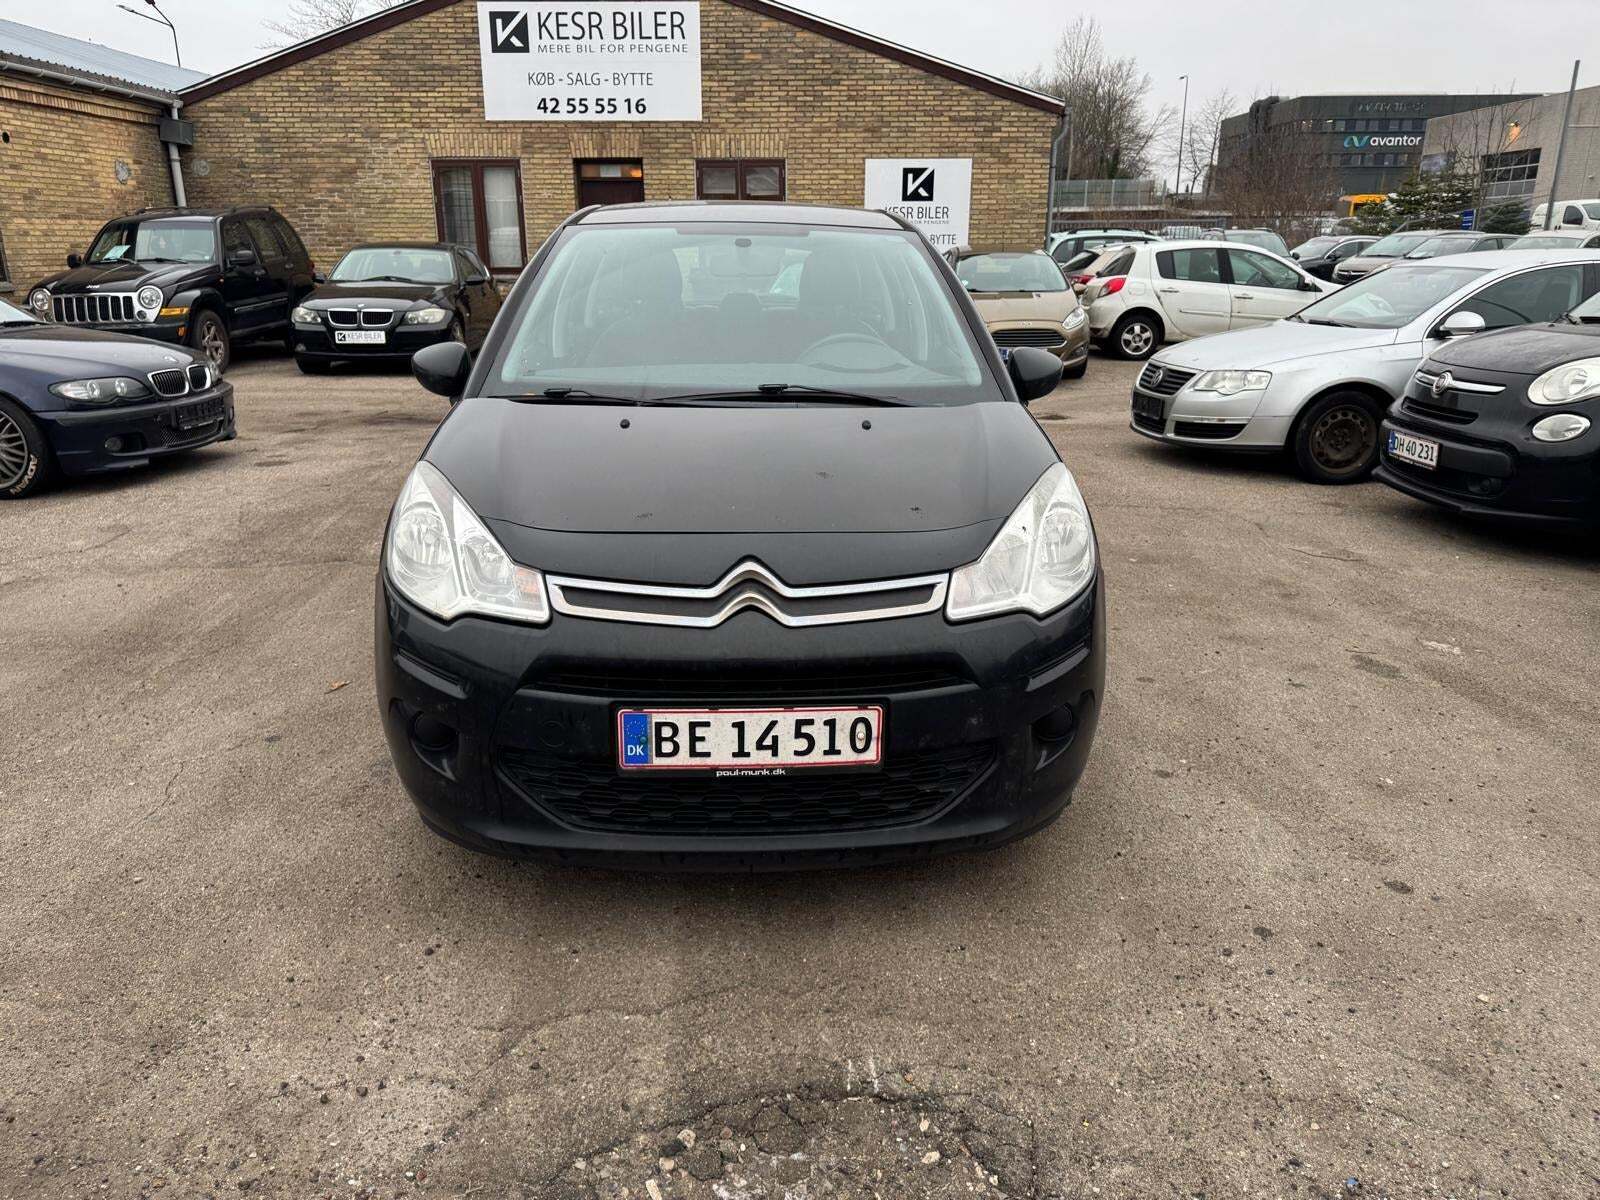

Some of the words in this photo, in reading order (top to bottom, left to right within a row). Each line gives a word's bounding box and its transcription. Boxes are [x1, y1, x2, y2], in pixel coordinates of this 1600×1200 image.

[537, 11, 604, 40] KESR
[612, 11, 686, 40] BILER
[537, 43, 572, 53] MERE
[576, 43, 594, 53] BIL
[600, 43, 625, 53] FOR
[629, 43, 688, 53] PENGENE
[527, 72, 555, 86] KØB
[567, 72, 601, 86] SALG
[612, 72, 654, 86] BYTTE
[536, 97, 561, 114] 42
[566, 97, 589, 114] 55
[594, 97, 618, 114] 55
[624, 97, 647, 114] 16
[1369, 134, 1422, 146] avantor
[917, 206, 949, 219] BILER
[930, 233, 957, 245] BYTTE
[1394, 436, 1405, 453] DH
[1405, 440, 1417, 456] 40
[1417, 443, 1434, 462] 231
[654, 720, 712, 758] BE
[731, 719, 780, 758] 14
[793, 716, 873, 757] 510
[627, 744, 644, 756] DK
[716, 768, 786, 777] paul-munk.dk
